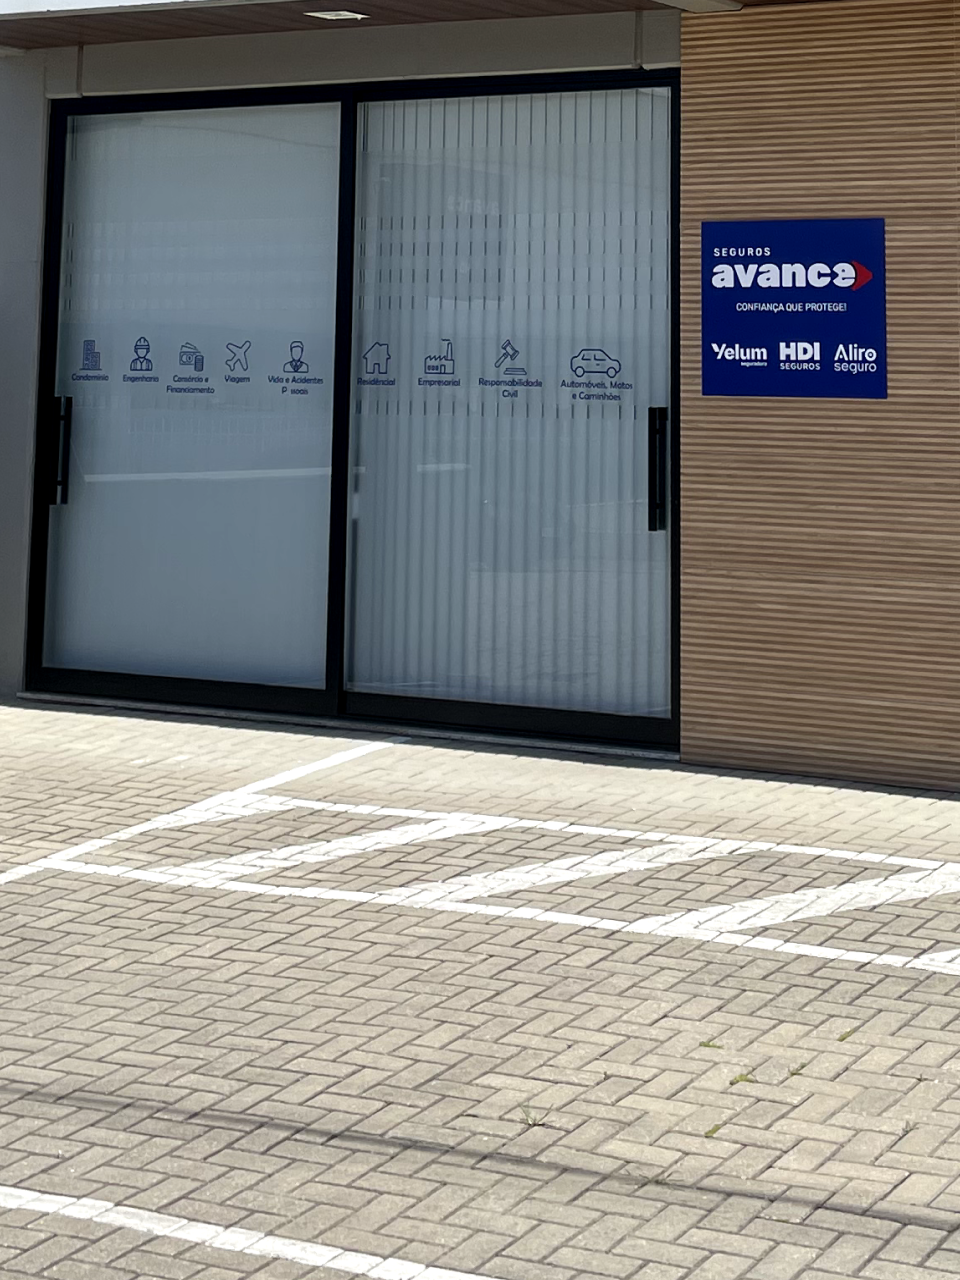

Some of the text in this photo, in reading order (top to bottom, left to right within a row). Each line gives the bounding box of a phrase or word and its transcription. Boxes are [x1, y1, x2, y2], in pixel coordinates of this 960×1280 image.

[713, 247, 771, 257] SEGUROS
[711, 262, 856, 288] avance
[736, 302, 847, 313] CONFIANÇA QUE PROTEGE!
[711, 342, 877, 362] Yelum HDI Aliro
[780, 363, 821, 371] SEGUROS
[833, 362, 877, 374] seguro
[122, 374, 159, 383] Engenharia
[224, 375, 251, 384] Viagem
[267, 375, 284, 383] Vida
[291, 375, 324, 384] Acidentes
[418, 377, 461, 387] Empresarial
[478, 378, 543, 387] Responsabilidade
[609, 380, 633, 389] Motos
[166, 385, 215, 394] Financiamento
[502, 389, 519, 398] Civil
